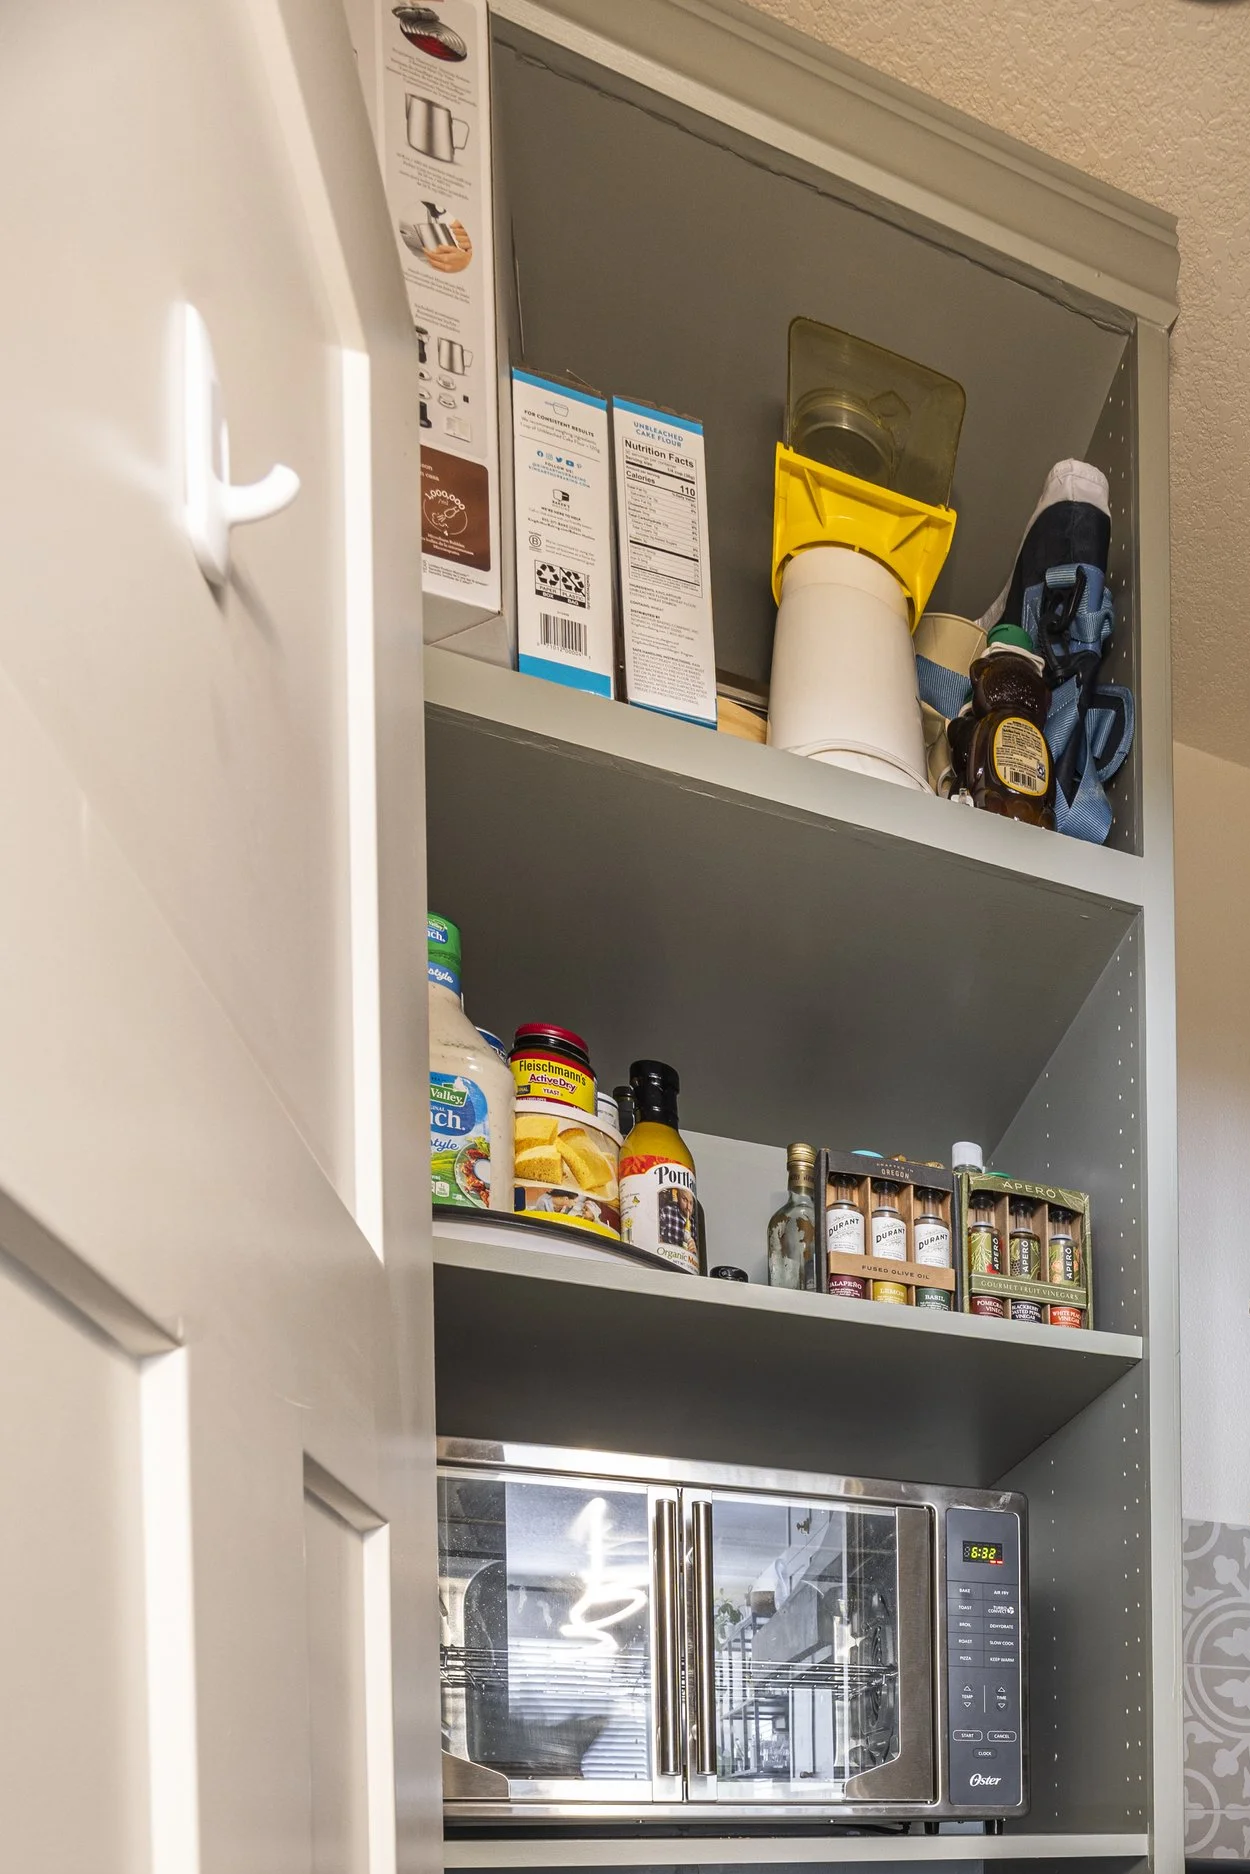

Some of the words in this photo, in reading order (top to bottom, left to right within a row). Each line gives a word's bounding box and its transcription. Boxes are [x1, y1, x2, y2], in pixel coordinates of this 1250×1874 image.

[524, 409, 535, 417] FOR
[537, 412, 571, 430] CONSISTENT
[571, 424, 595, 438] RESULTS
[633, 421, 684, 443] UNBLEACHED
[636, 426, 657, 438] CAKE
[657, 432, 683, 448] FLOUR
[624, 439, 667, 460] Nutrition
[668, 452, 695, 468] Facts
[626, 470, 655, 485] Calories
[680, 485, 696, 497] 110
[539, 585, 557, 594] PAPER
[542, 591, 554, 599] BOX
[562, 591, 584, 601] PLASTIC
[567, 598, 579, 606] BAG
[519, 1060, 587, 1087] Fleischmann's
[529, 1073, 558, 1087] Active
[558, 1078, 577, 1094] Dry
[542, 1087, 560, 1097] YEAST
[881, 1168, 910, 1179] OREGON
[828, 1218, 860, 1237] DURANT
[875, 1228, 906, 1244] DURANT
[918, 1234, 949, 1250] DURANT
[656, 1246, 687, 1262] Organic
[861, 1265, 889, 1274] FUSED
[891, 1269, 915, 1278] OLIVE
[880, 1287, 904, 1296] LEMON
[980, 1280, 1018, 1291] GOURMET
[1020, 1285, 1042, 1295] FRUIT
[1043, 1288, 1079, 1301] VINEGARS
[924, 1294, 945, 1302] BASIL
[1015, 1313, 1036, 1321] VINEGAR
[1052, 1310, 1072, 1318] WHITE
[1058, 1315, 1080, 1325] VINEGAR
[971, 1547, 996, 1559] 6:32
[969, 1773, 1001, 1787] Oster
